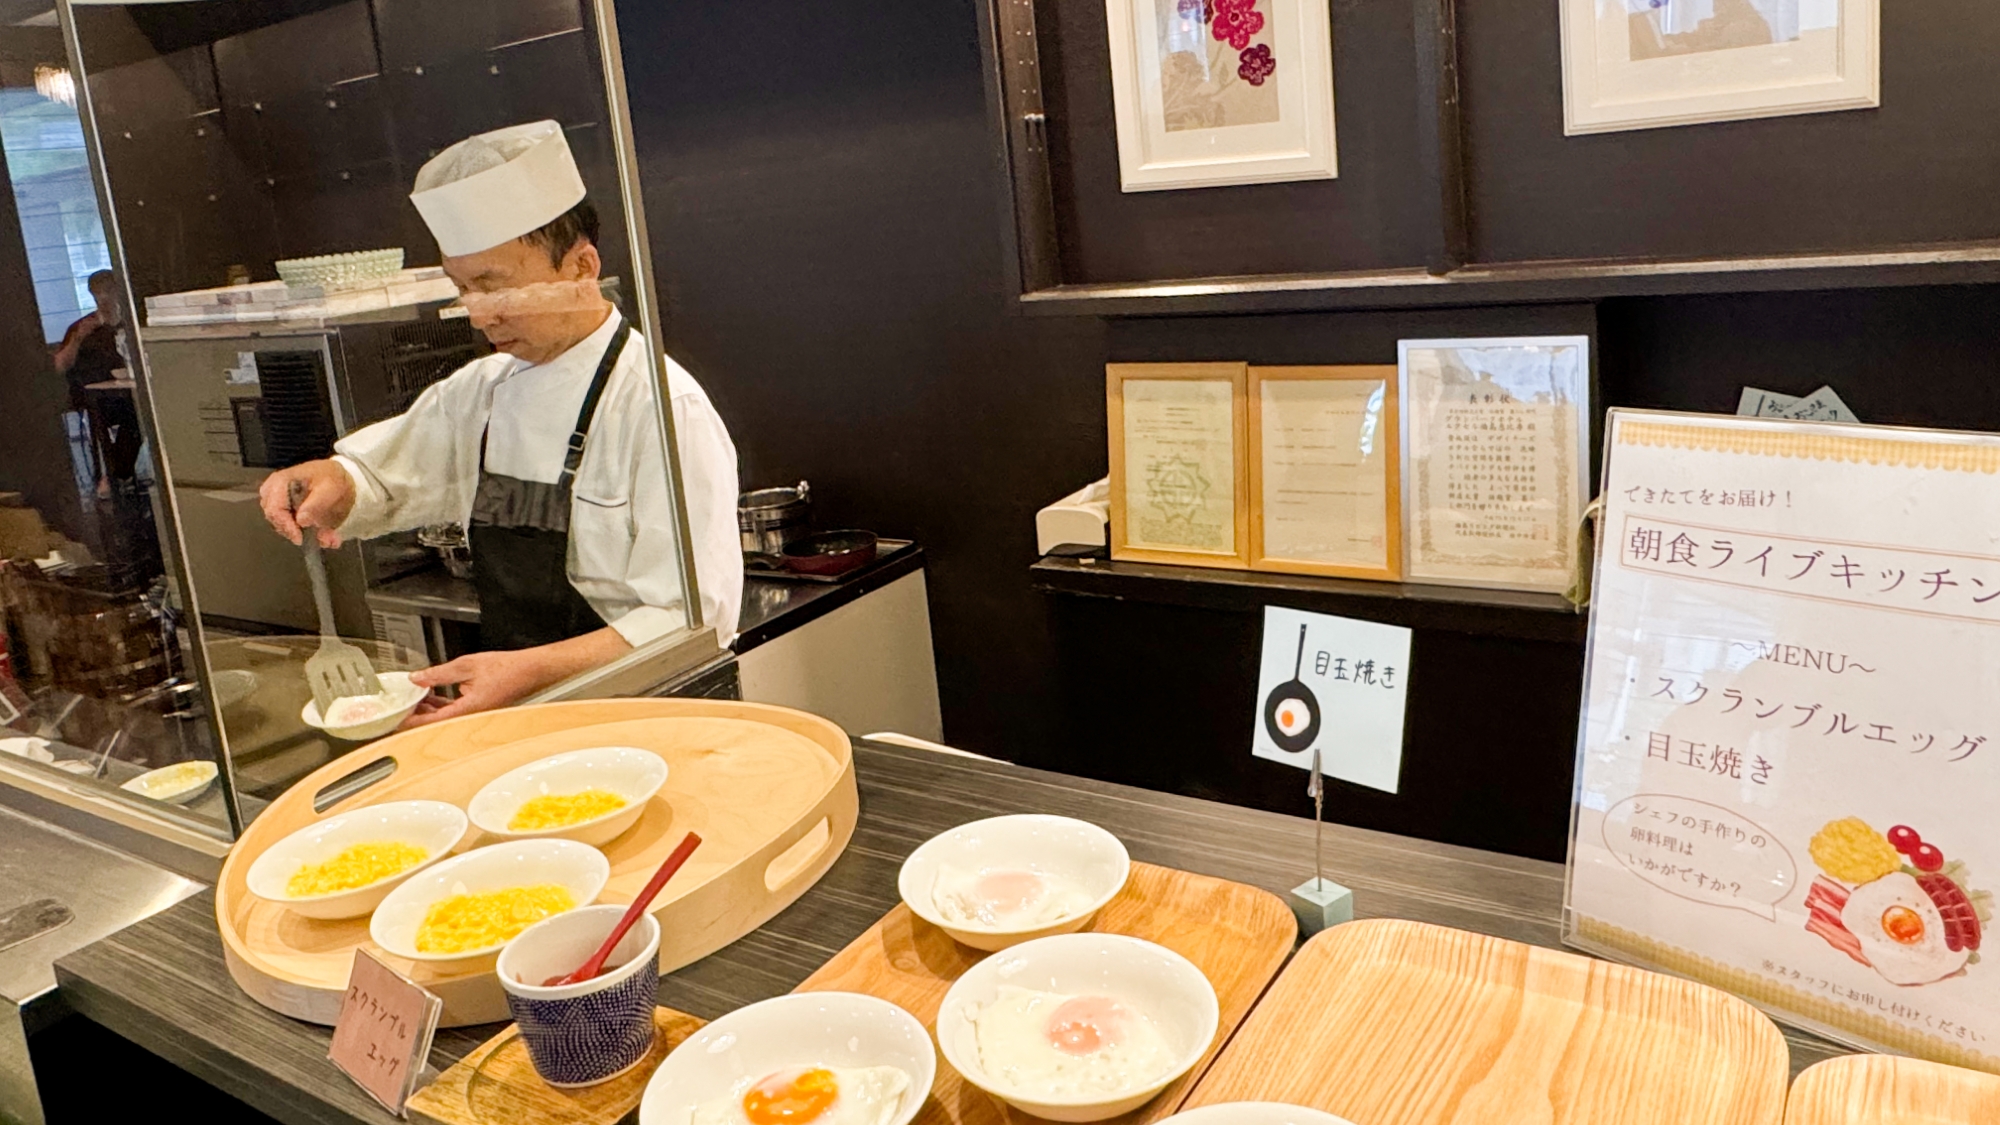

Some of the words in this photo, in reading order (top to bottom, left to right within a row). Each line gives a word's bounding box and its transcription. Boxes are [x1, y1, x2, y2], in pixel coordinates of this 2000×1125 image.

[1624, 486, 1793, 508] できたてをお届け！
[1629, 526, 2000, 604] 朝食ライブキッチン
[1315, 650, 1395, 689] 目玉焼き
[1630, 826, 1693, 856] 卵料理は
[1633, 802, 1767, 848] シェフの手作りの
[1628, 853, 1741, 897] いかがですか？
[350, 985, 406, 1039] スクランブル
[366, 1042, 400, 1076] エッグ
